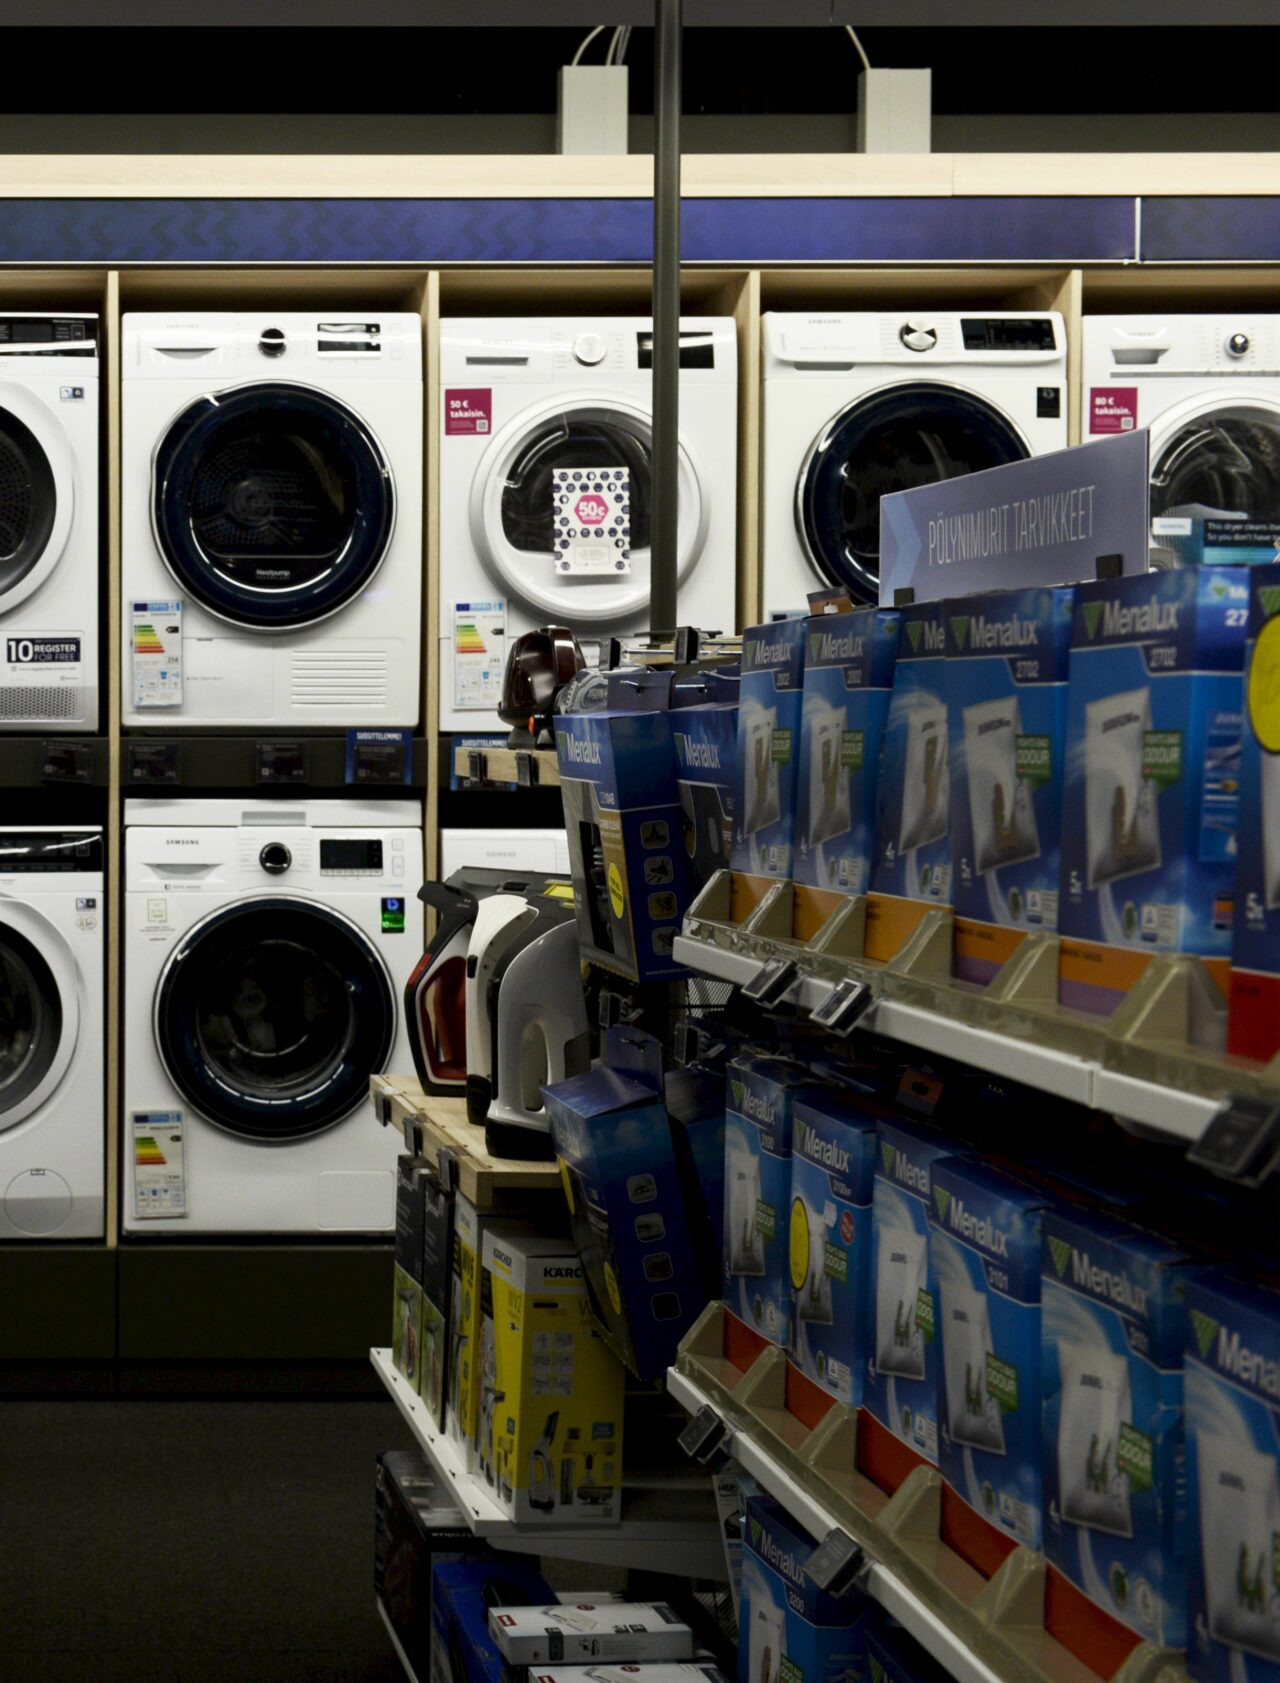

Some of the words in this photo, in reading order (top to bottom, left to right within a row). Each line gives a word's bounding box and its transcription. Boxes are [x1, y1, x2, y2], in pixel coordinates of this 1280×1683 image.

[928, 504, 1009, 567] PÖLYNIMURIT
[1013, 485, 1096, 551] TARVIKKEET
[970, 612, 1038, 649] Menalux
[1102, 595, 1179, 636] Menalux
[1224, 608, 1249, 627] 27
[8, 640, 33, 661] 10
[34, 644, 76, 652] REGISTER
[754, 639, 792, 665] Menalux
[821, 630, 864, 659] Menalux
[1015, 661, 1039, 678] 2702
[567, 732, 602, 765] Menalux
[683, 735, 721, 769] Menalux
[743, 1085, 775, 1125] Menalux
[804, 1126, 849, 1173] Menalux
[895, 1150, 930, 1194] Menal
[950, 1197, 1009, 1258] Menalux
[544, 1267, 583, 1278] KÄRC
[1072, 1249, 1148, 1318] Menalux
[1220, 1326, 1280, 1396] Mena
[760, 1530, 806, 1588] Menalux
